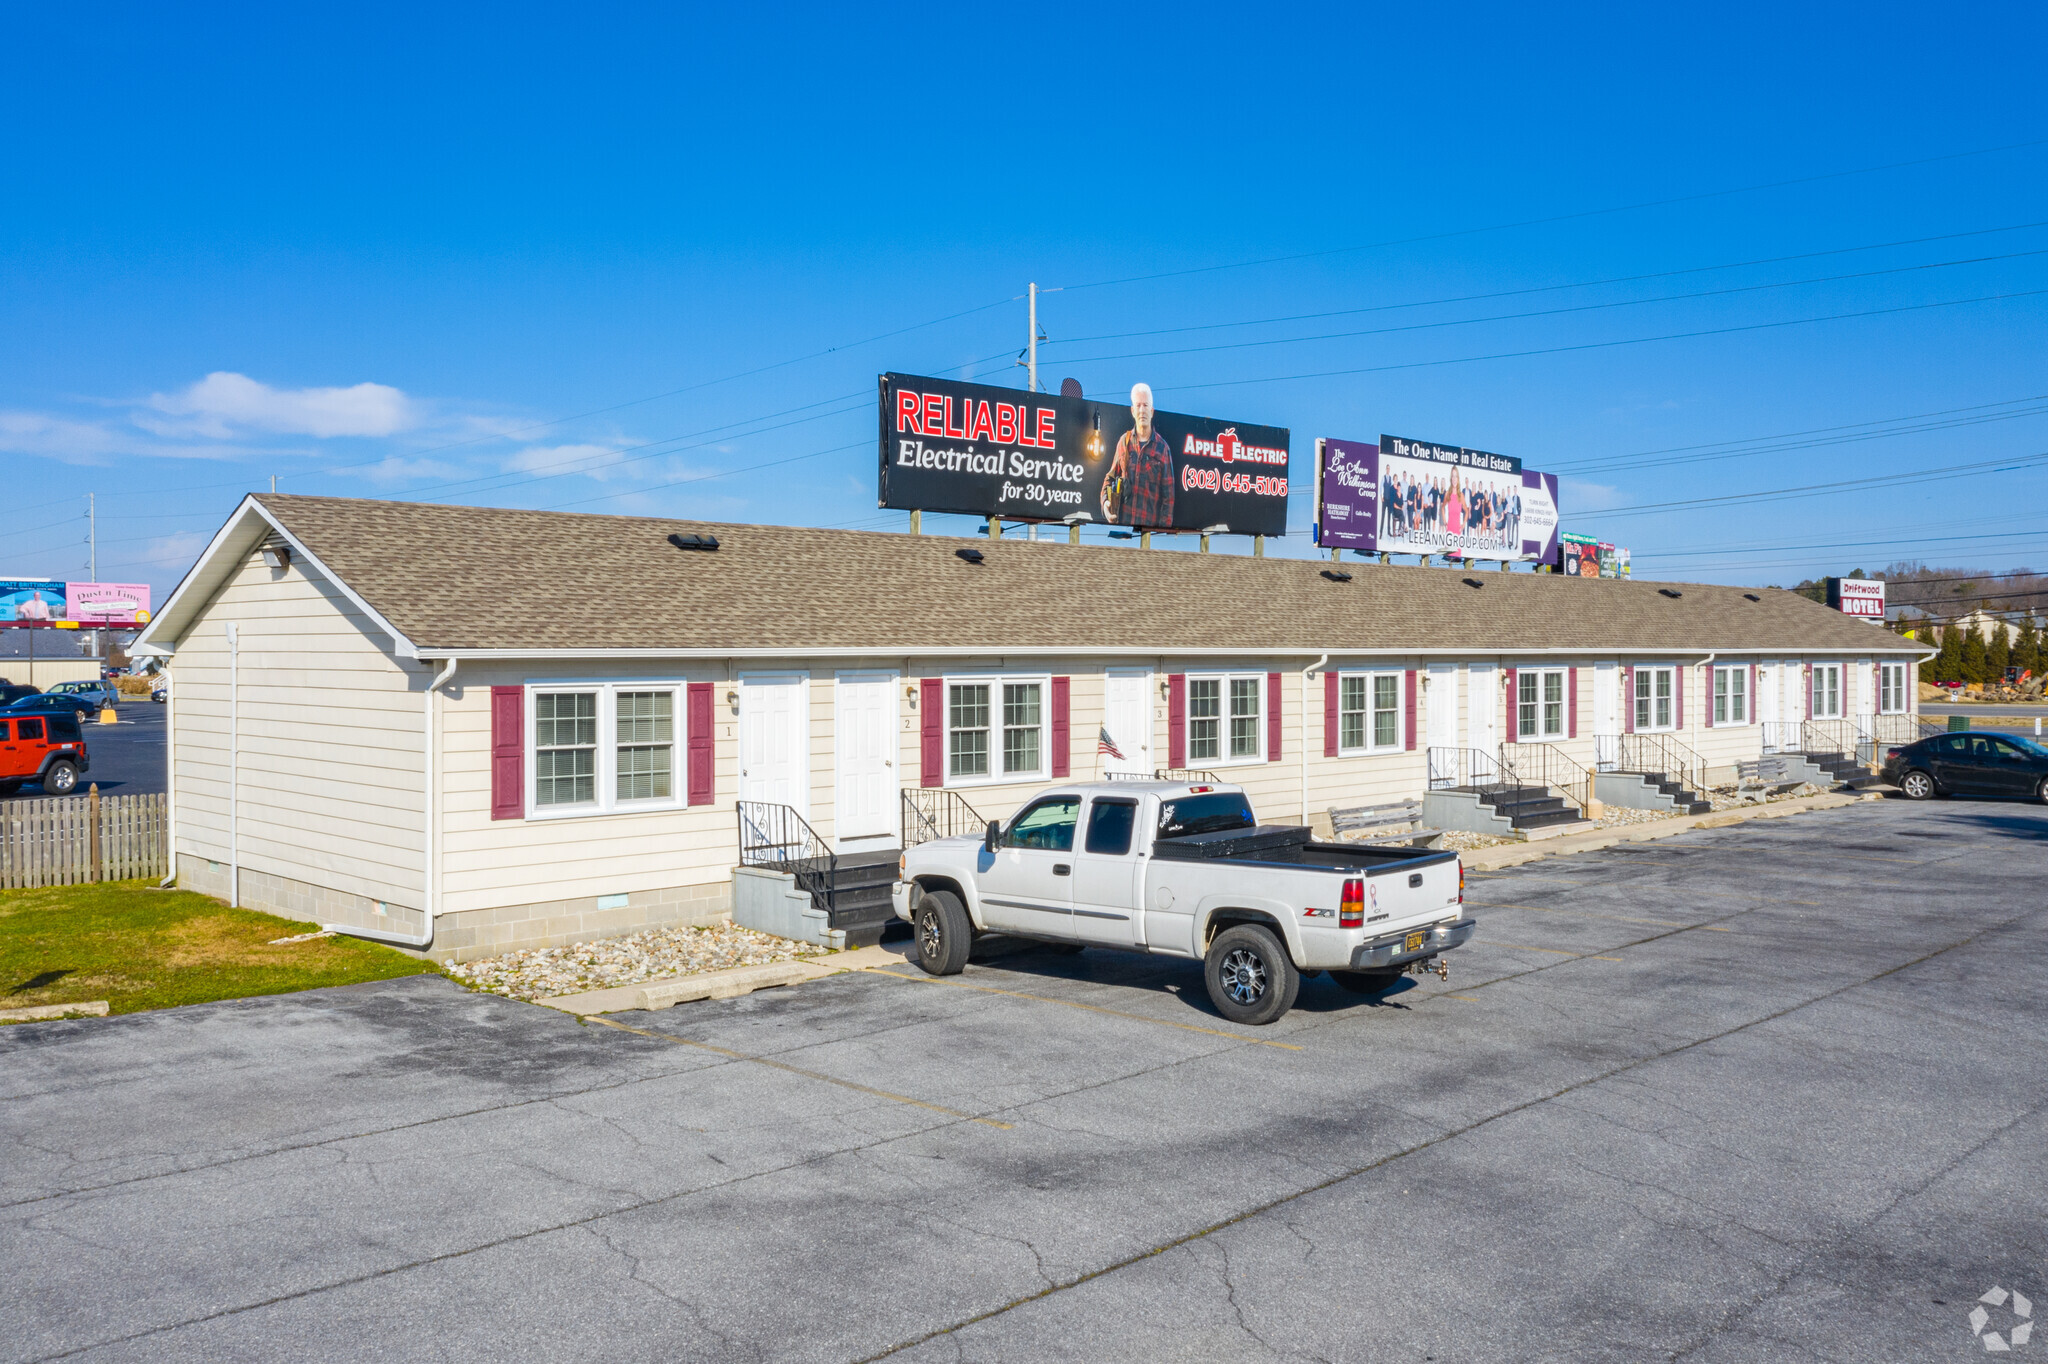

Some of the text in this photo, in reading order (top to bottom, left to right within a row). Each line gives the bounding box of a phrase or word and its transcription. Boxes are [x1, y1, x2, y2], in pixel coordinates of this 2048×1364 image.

[897, 389, 1056, 449] RELIABLE
[1184, 434, 1287, 465] APPLE ELECTRIC
[1334, 448, 1345, 459] The
[1393, 440, 1512, 472] The One Name in Real Estate
[897, 440, 1084, 483] Electrical Service
[1182, 464, 1288, 497] (302) 645-5105
[1337, 472, 1376, 489] Wilkinson
[999, 481, 1082, 506] for 30 years
[1358, 488, 1376, 500] Group
[77, 590, 101, 601] Dust
[117, 589, 142, 602] Time
[1844, 584, 1880, 594] Driftwood
[1842, 598, 1881, 614] MOTEL
[1157, 710, 1162, 719] 3
[904, 719, 910, 729] 2
[726, 726, 731, 737] 1
[1303, 907, 1335, 918] Z71
